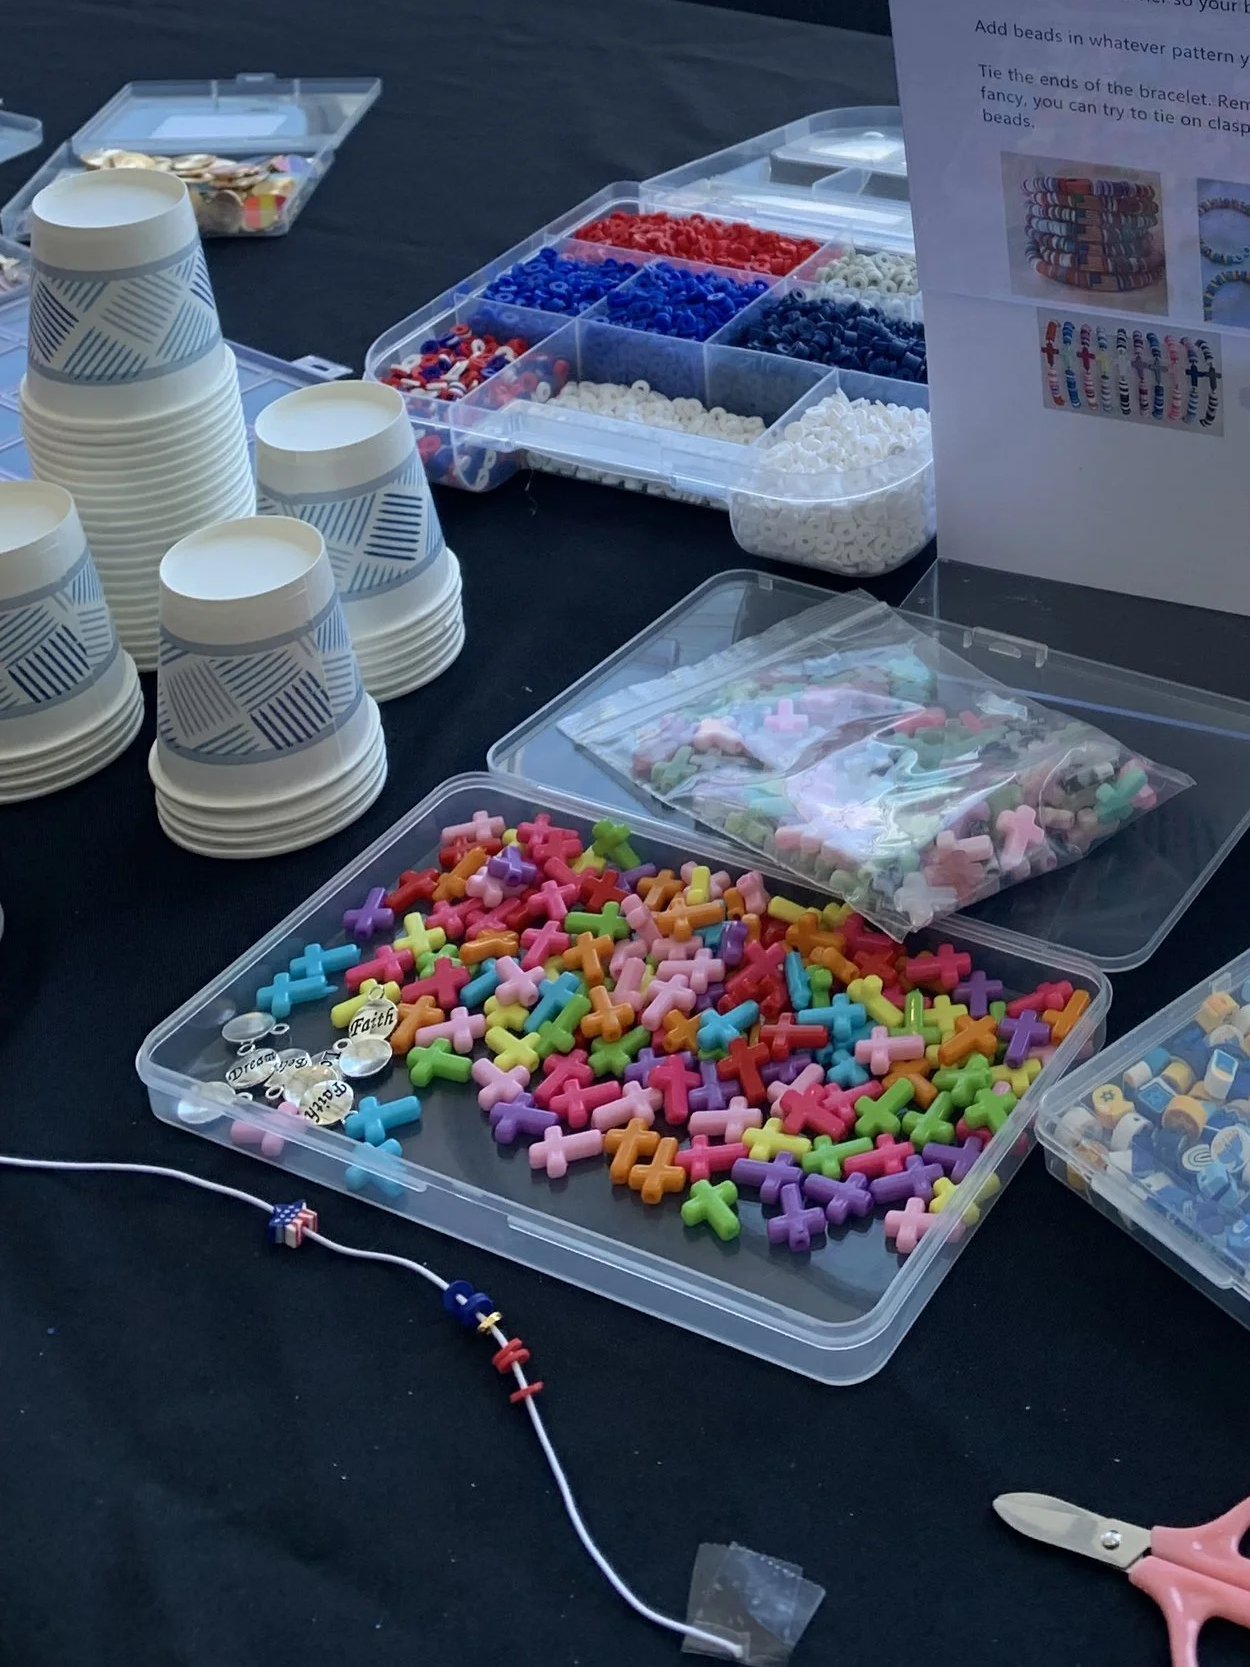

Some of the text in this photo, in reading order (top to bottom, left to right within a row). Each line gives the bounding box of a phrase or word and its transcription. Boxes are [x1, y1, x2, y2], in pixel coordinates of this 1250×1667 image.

[975, 20, 1007, 36] Add
[1014, 24, 1062, 43] beads
[1069, 29, 1083, 45] in
[1089, 33, 1165, 55] whatever
[1173, 45, 1234, 63] pattern
[978, 64, 1001, 80] Tie
[1008, 68, 1034, 84] the
[1040, 73, 1078, 90] ends
[1085, 76, 1101, 92] of
[1108, 79, 1133, 96] the
[1140, 84, 1211, 106] bracelet.
[980, 86, 1027, 107] fancy,
[1033, 95, 1062, 110] you
[1069, 100, 1096, 114] can
[1103, 104, 1124, 120] try
[1130, 107, 1147, 121] to
[1154, 110, 1175, 124] tie
[1181, 115, 1201, 127] on
[983, 108, 1035, 129] beads.
[350, 1007, 394, 1036] Faith
[228, 1051, 275, 1081] Dream
[305, 1082, 347, 1123] Faith
